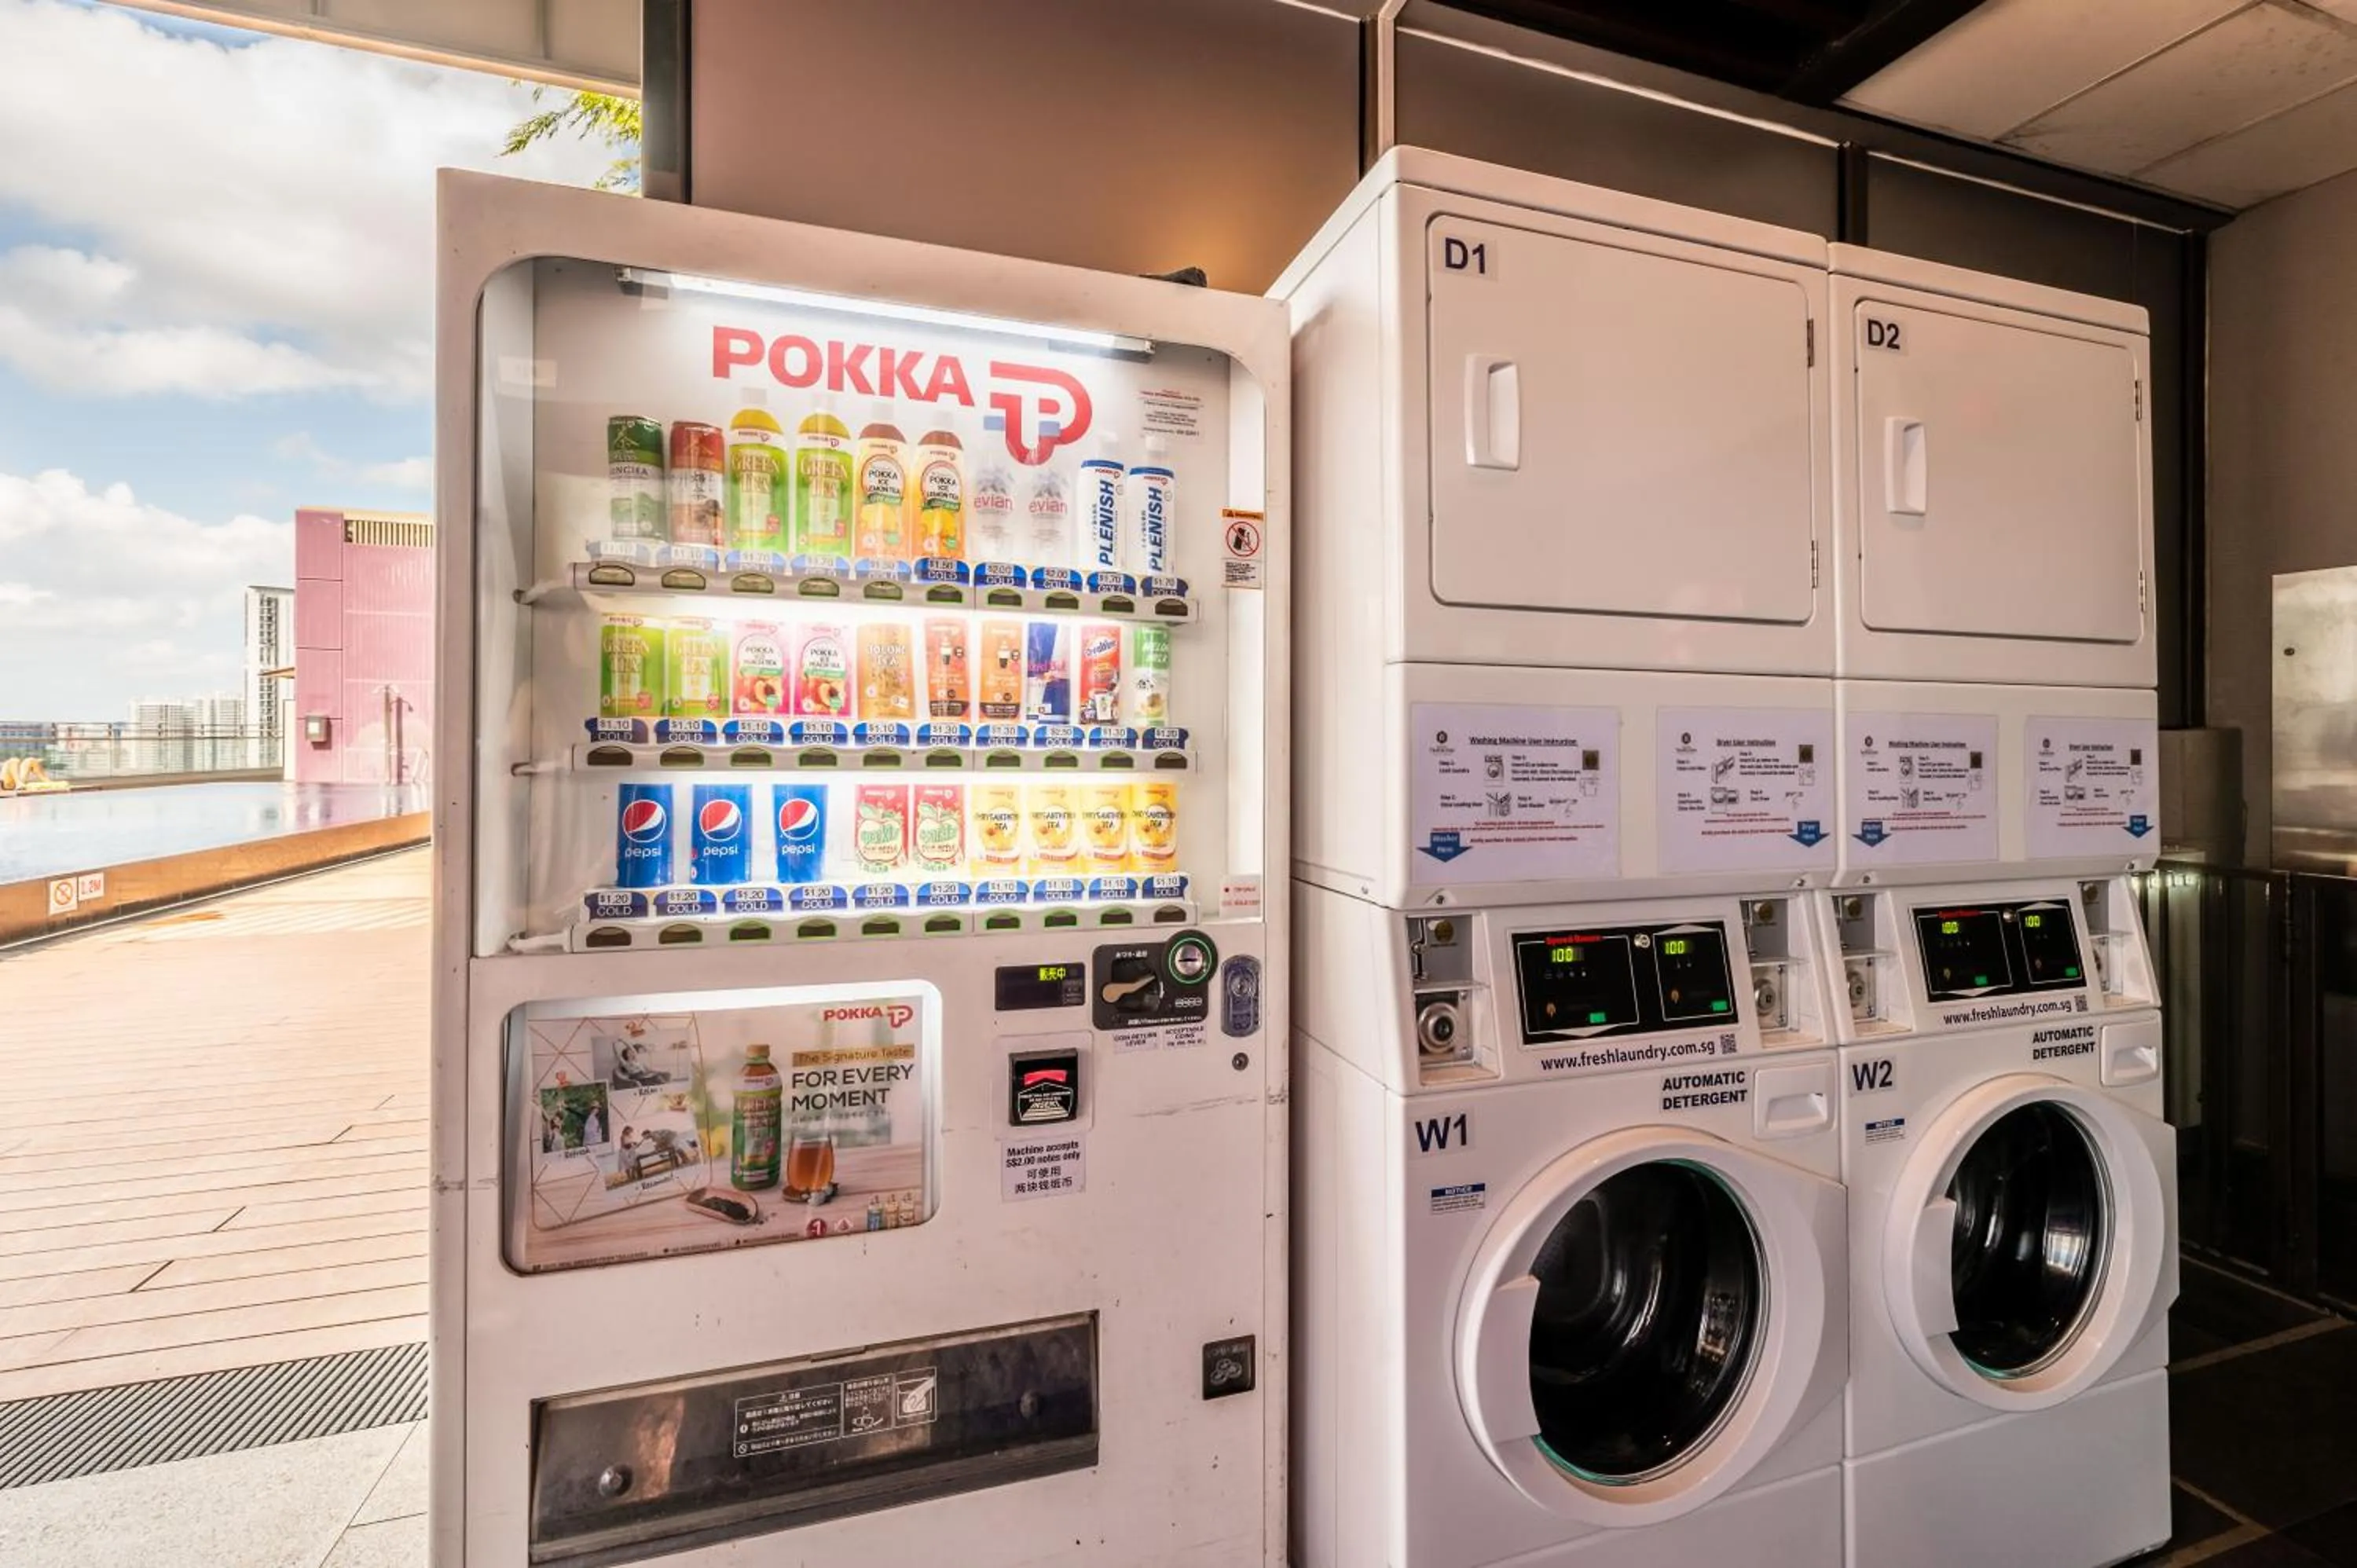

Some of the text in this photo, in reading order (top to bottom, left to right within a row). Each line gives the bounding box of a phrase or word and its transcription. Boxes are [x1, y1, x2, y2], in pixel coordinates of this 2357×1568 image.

[1445, 237, 1485, 274] D1
[1868, 318, 1900, 350] D2
[712, 325, 975, 407] POKKA
[973, 495, 1014, 511] evian
[1028, 498, 1068, 515] evian
[1098, 480, 1115, 566] PLENISH
[1148, 486, 1163, 572] PLENISH
[600, 719, 629, 729] $1.10
[671, 720, 701, 730] $1.10
[741, 722, 768, 732] $1.10
[805, 724, 832, 734] $1.10
[869, 724, 895, 733] $1.10
[933, 724, 958, 734] $1.30
[597, 731, 633, 742] COLD
[669, 732, 703, 742] COLD
[736, 734, 769, 743] COLD
[802, 735, 834, 744] COLD
[867, 735, 896, 745] COLD
[930, 736, 959, 746] COLD
[988, 737, 1017, 746] COLD
[1046, 738, 1074, 746] COLD
[1468, 736, 1497, 746] Washing
[1498, 737, 1526, 746] Machine
[625, 846, 662, 858] pepsi
[703, 844, 739, 857] pepsi
[782, 843, 816, 855] pepsi
[991, 881, 1015, 891] $1.10
[1048, 880, 1072, 889] $1.10
[1102, 878, 1126, 888] $1.10
[1156, 877, 1178, 886] $1.10
[737, 890, 764, 900] $1.20
[804, 888, 830, 898] $1.20
[867, 886, 893, 896] $1.20
[932, 885, 956, 894] $1.20
[1101, 890, 1127, 899] COLD
[1154, 888, 1179, 897] COLD
[599, 892, 629, 903] $1.20
[669, 892, 698, 902] $1.20
[930, 895, 959, 904] COLD
[989, 893, 1017, 903] COLD
[1047, 891, 1073, 900] COLD
[735, 901, 768, 912] COLD
[801, 899, 834, 910] COLD
[865, 897, 895, 907] COLD
[597, 905, 632, 917] COLD
[667, 903, 702, 914] COLD
[1665, 940, 1685, 954] 100
[1551, 947, 1574, 963] 100
[823, 1006, 883, 1021] POKKA
[1943, 1001, 2073, 1025] www.freshlaundry.com.sg
[2032, 1026, 2095, 1044] AUTOMATIC
[798, 1046, 909, 1064] The Signature Taste
[1541, 1039, 1716, 1072] www.freshlaundry.com.sg
[2032, 1042, 2096, 1060] DETERGENT
[792, 1064, 915, 1090] FOR EVERY
[1852, 1060, 1893, 1090] W2
[1662, 1071, 1746, 1091] AUTOMATIC
[791, 1087, 890, 1112] MOMENT
[1662, 1090, 1748, 1110] DETERGENT
[1415, 1114, 1468, 1153] W1
[1007, 1141, 1080, 1156] Machine accepts
[1006, 1150, 1080, 1167] S$2.00 notes only
